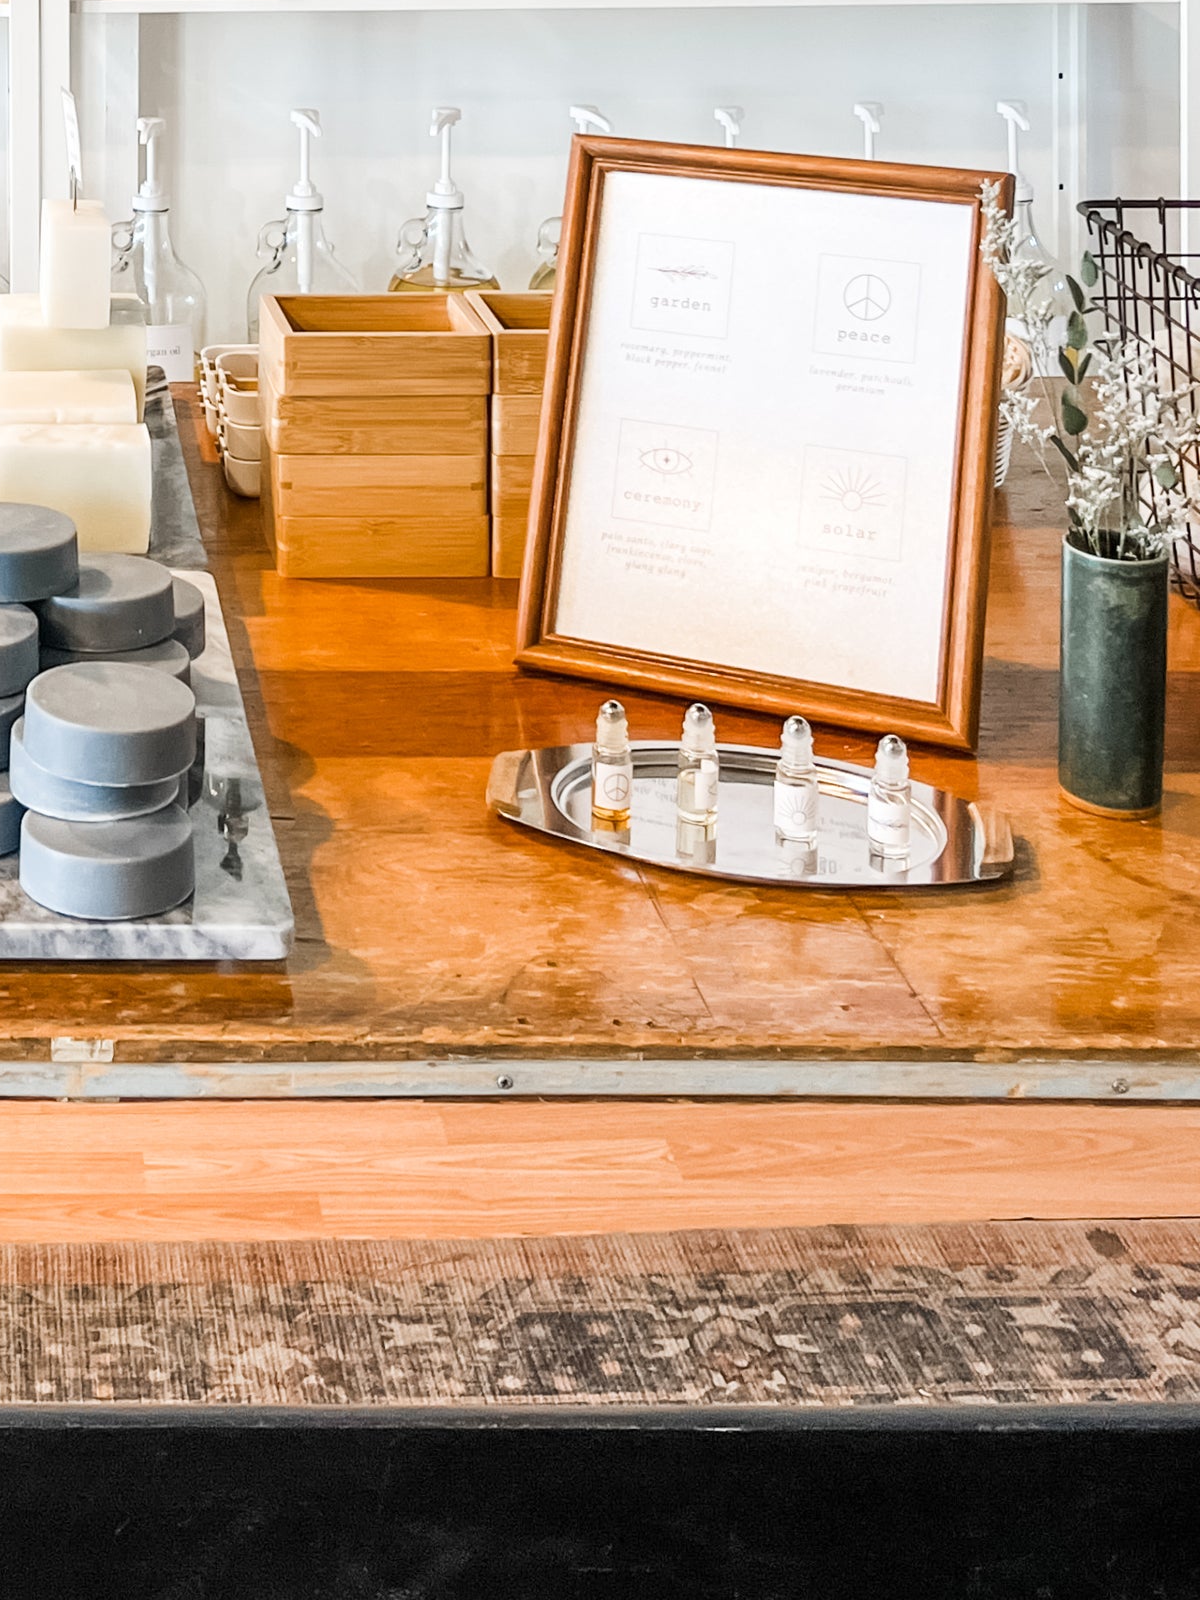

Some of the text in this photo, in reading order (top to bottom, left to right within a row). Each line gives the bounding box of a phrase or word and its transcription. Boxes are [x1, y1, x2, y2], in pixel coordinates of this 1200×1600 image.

[650, 296, 711, 312] garden
[837, 330, 891, 344] peace
[146, 346, 181, 357] rgan oil
[620, 342, 669, 356] rosemary,
[625, 353, 651, 363] black
[654, 358, 691, 370] pepper,
[808, 366, 857, 379] lavender,
[835, 383, 885, 396] geranium
[623, 489, 701, 512] ceremony
[822, 523, 878, 541] solar
